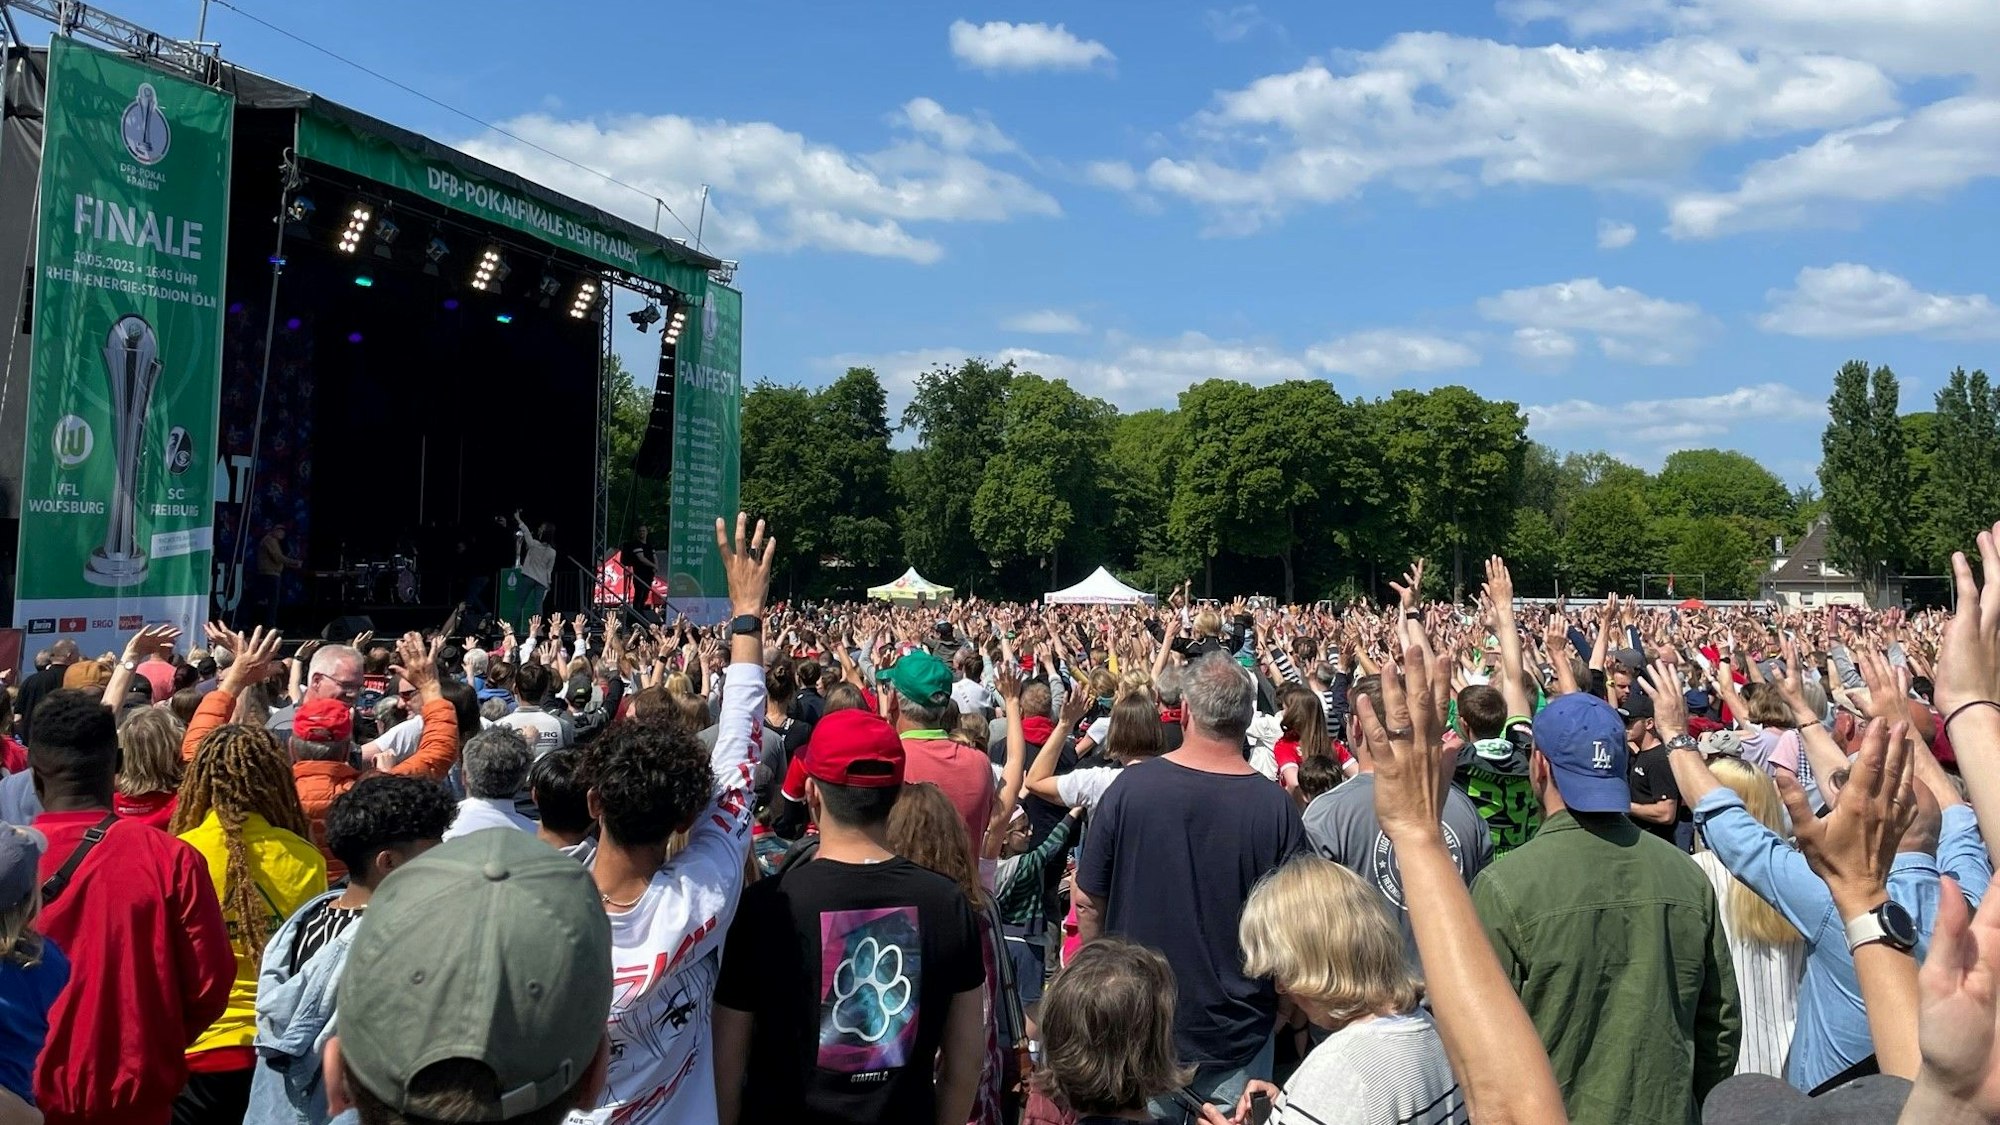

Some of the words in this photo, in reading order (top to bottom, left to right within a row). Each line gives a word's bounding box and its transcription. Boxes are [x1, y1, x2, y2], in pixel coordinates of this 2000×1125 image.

[120, 162, 167, 183] DFB-POKAL
[126, 175, 160, 191] FRAUEN
[427, 166, 563, 237] DFB-POKALFINALE
[565, 220, 591, 249] DER
[593, 231, 639, 267] FRAUEN
[74, 193, 203, 260] FINALE
[145, 265, 173, 282] 16:45
[175, 273, 198, 286] UHR
[57, 483, 79, 496] VFL
[167, 488, 185, 500] SC
[29, 500, 104, 514] WOLFSBURG
[151, 504, 198, 517] FREIBURG
[92, 620, 113, 629] ERGO
[1592, 741, 1612, 769] LA
[850, 1072, 881, 1083] STAFFEL
[882, 1070, 889, 1081] 2
